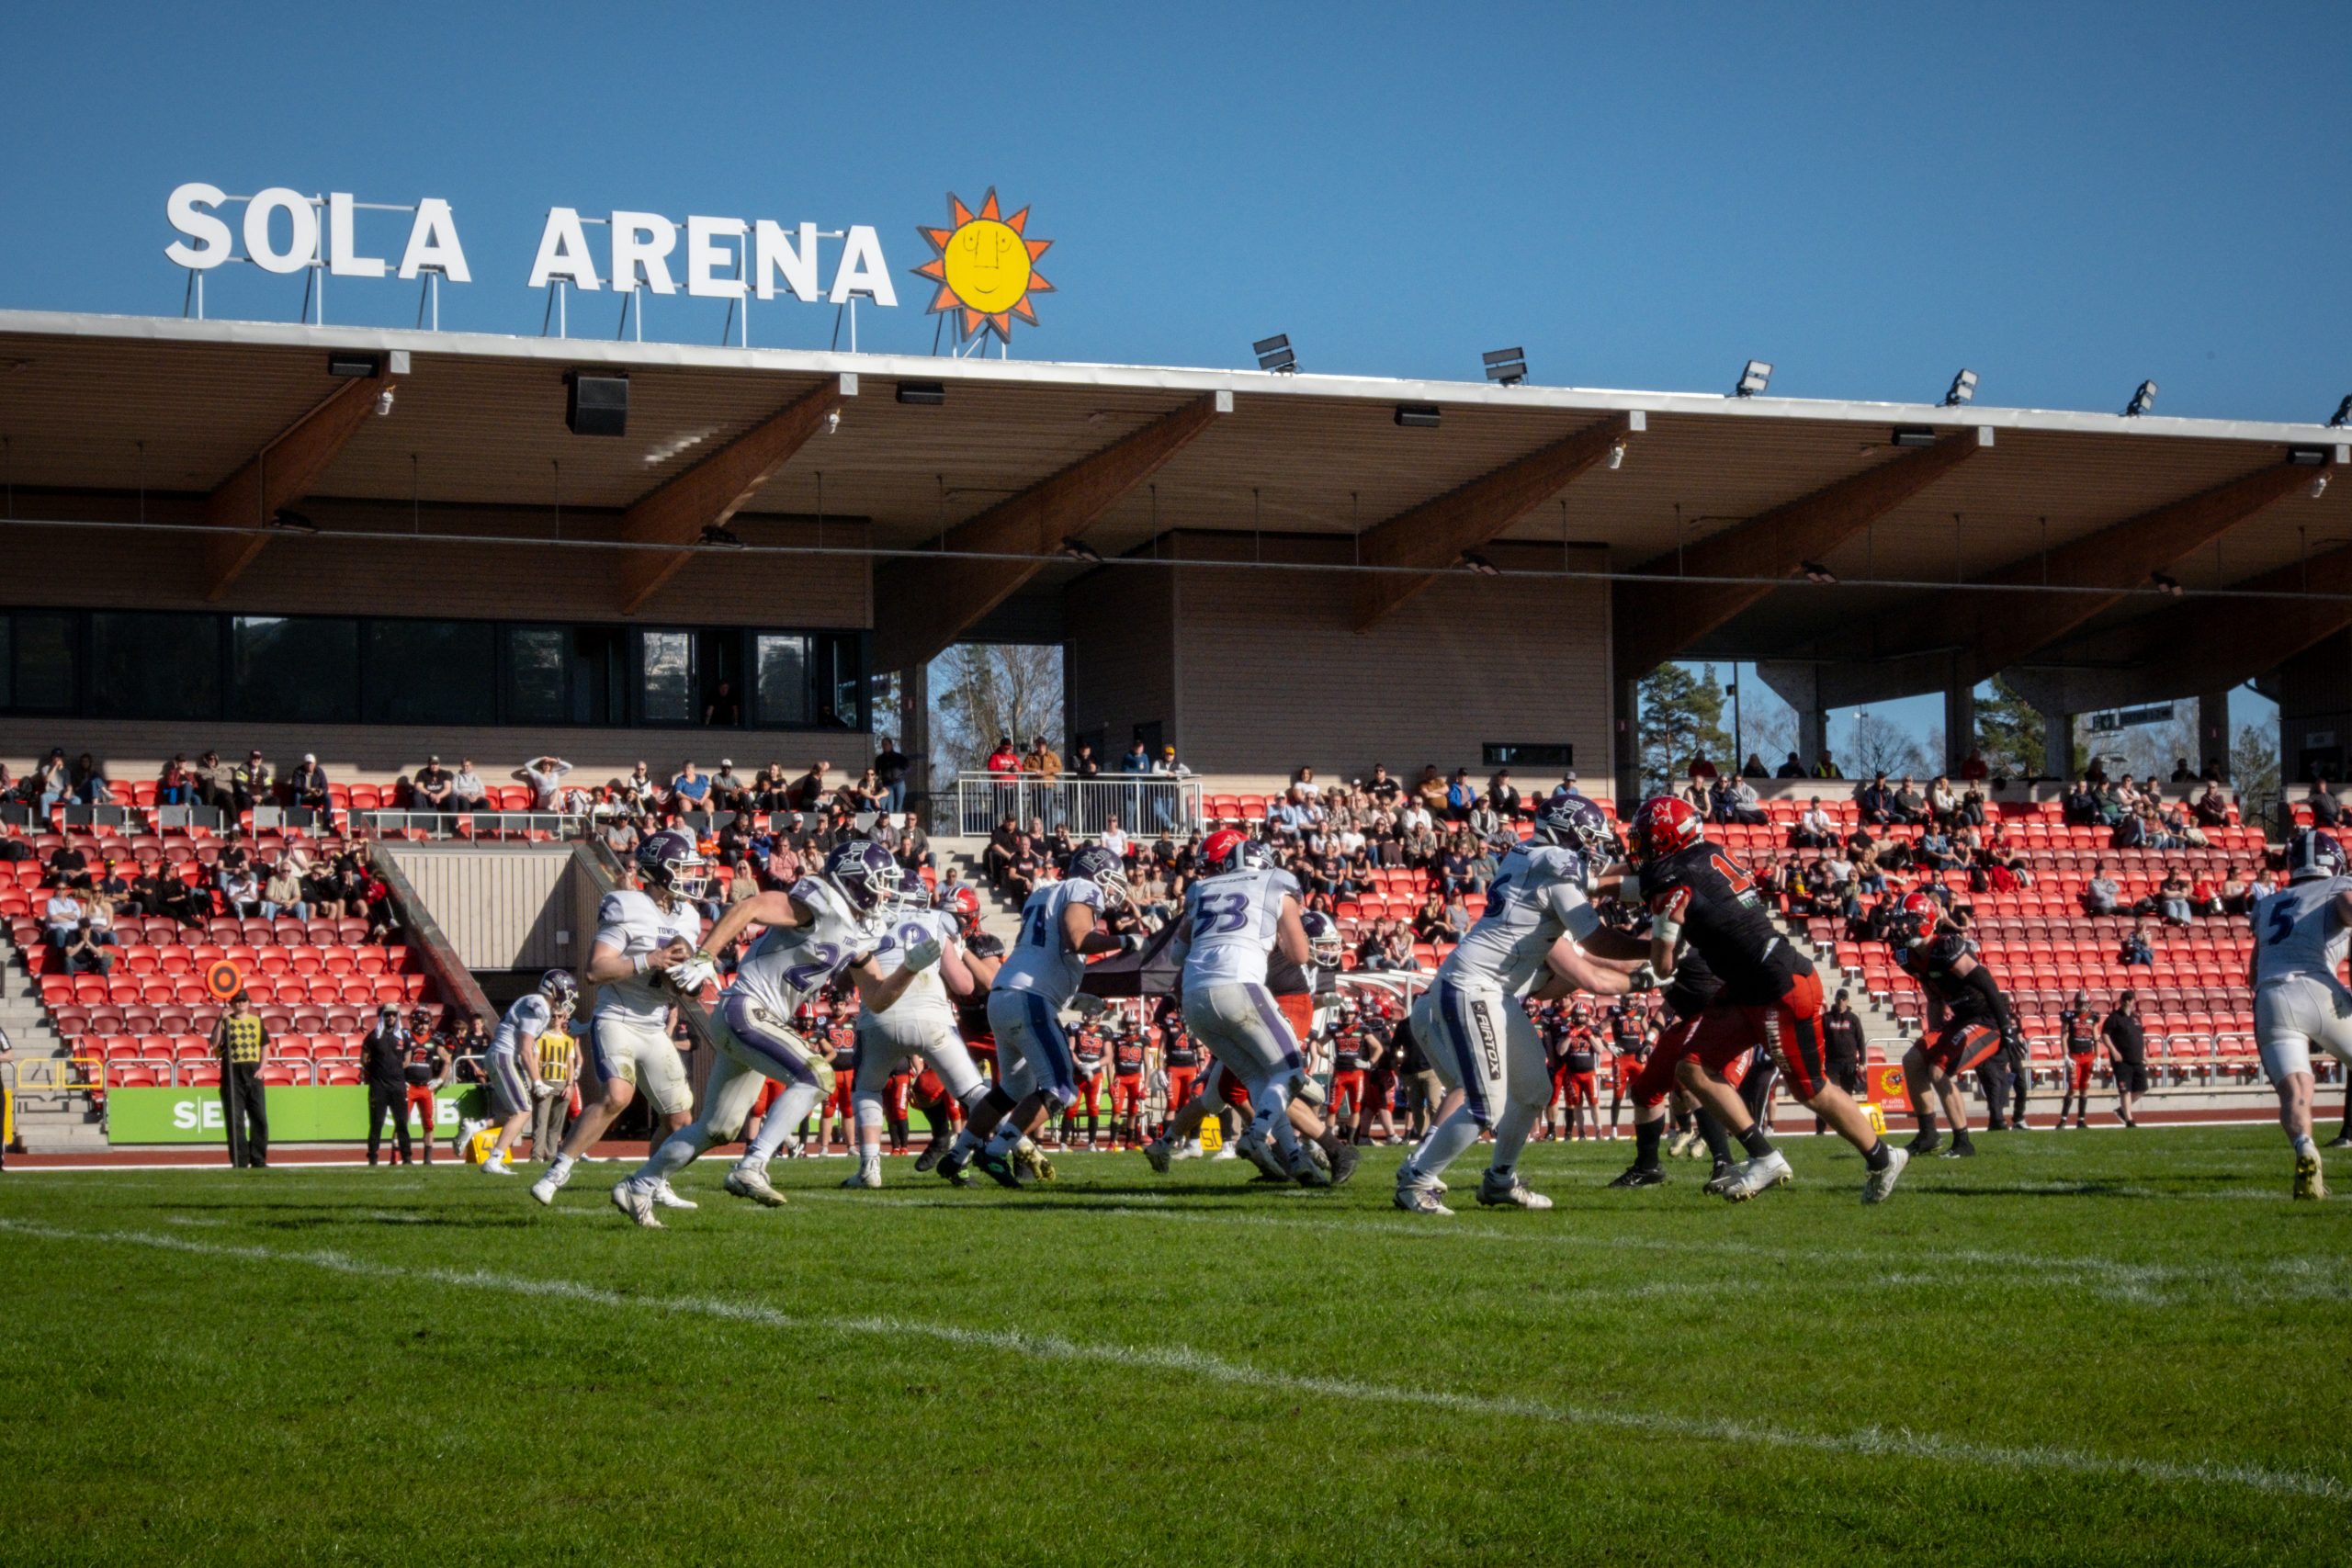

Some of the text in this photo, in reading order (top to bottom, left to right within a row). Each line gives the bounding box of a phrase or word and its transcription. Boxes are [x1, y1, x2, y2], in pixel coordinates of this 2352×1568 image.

[164, 182, 899, 307] SOLA ARENA
[1193, 891, 1250, 939] 53
[2268, 897, 2301, 946] 5
[829, 1029, 854, 1048] 58
[1175, 1032, 1189, 1050] 4
[1476, 1013, 1500, 1075] AIRTOX
[173, 1098, 250, 1132] SE
[1201, 1128, 1222, 1147] 50
